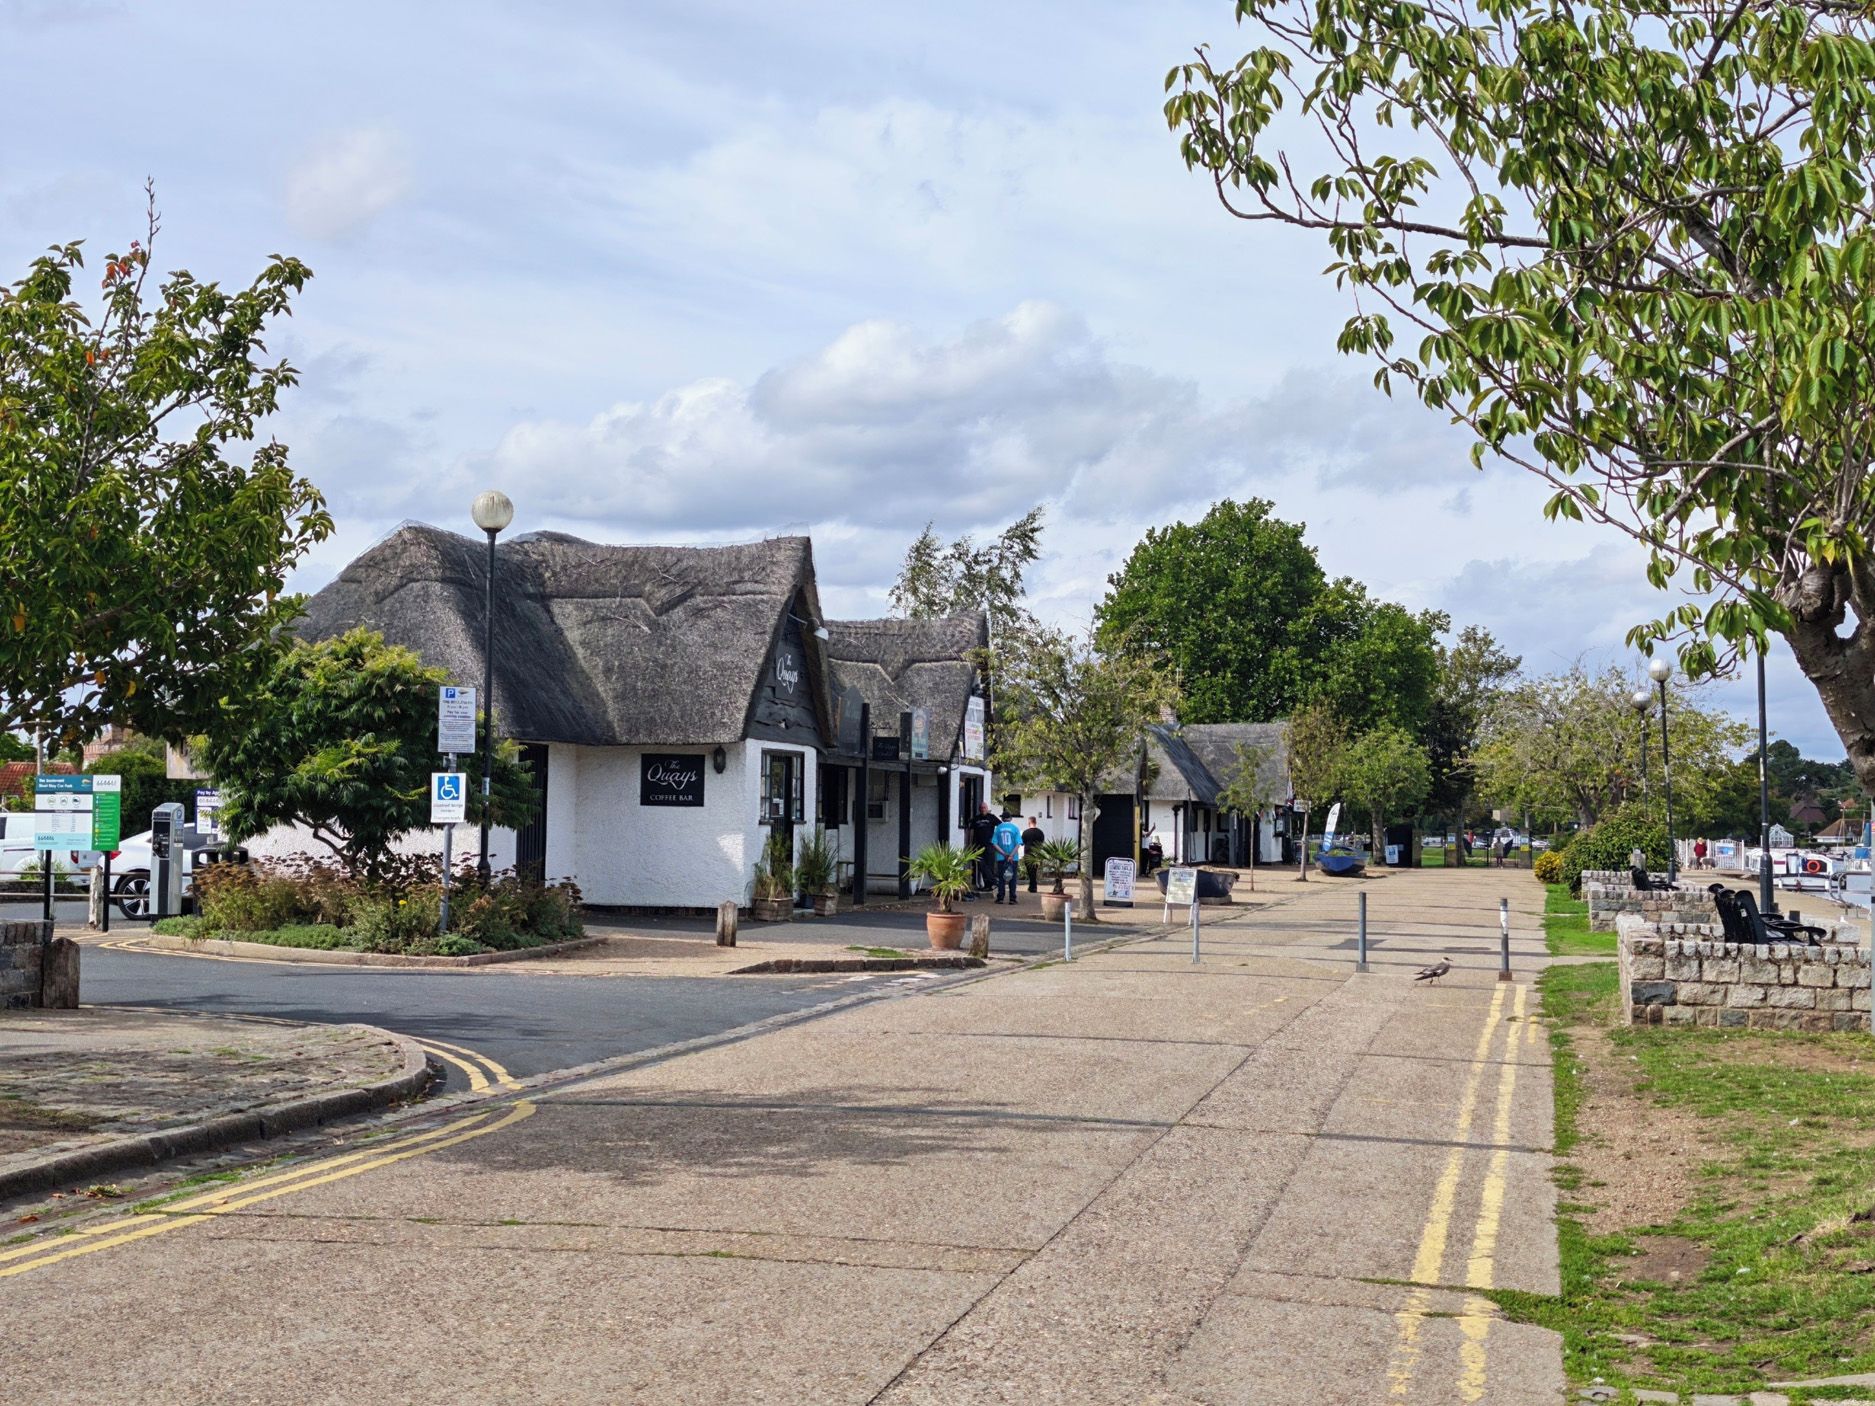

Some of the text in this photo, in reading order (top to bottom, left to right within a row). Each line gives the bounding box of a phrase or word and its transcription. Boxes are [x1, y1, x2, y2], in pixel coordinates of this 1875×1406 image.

[777, 657, 798, 695] Quays
[448, 689, 454, 698] P
[664, 760, 681, 769] The
[648, 763, 697, 790] Quays
[1001, 831, 1012, 845] 10
